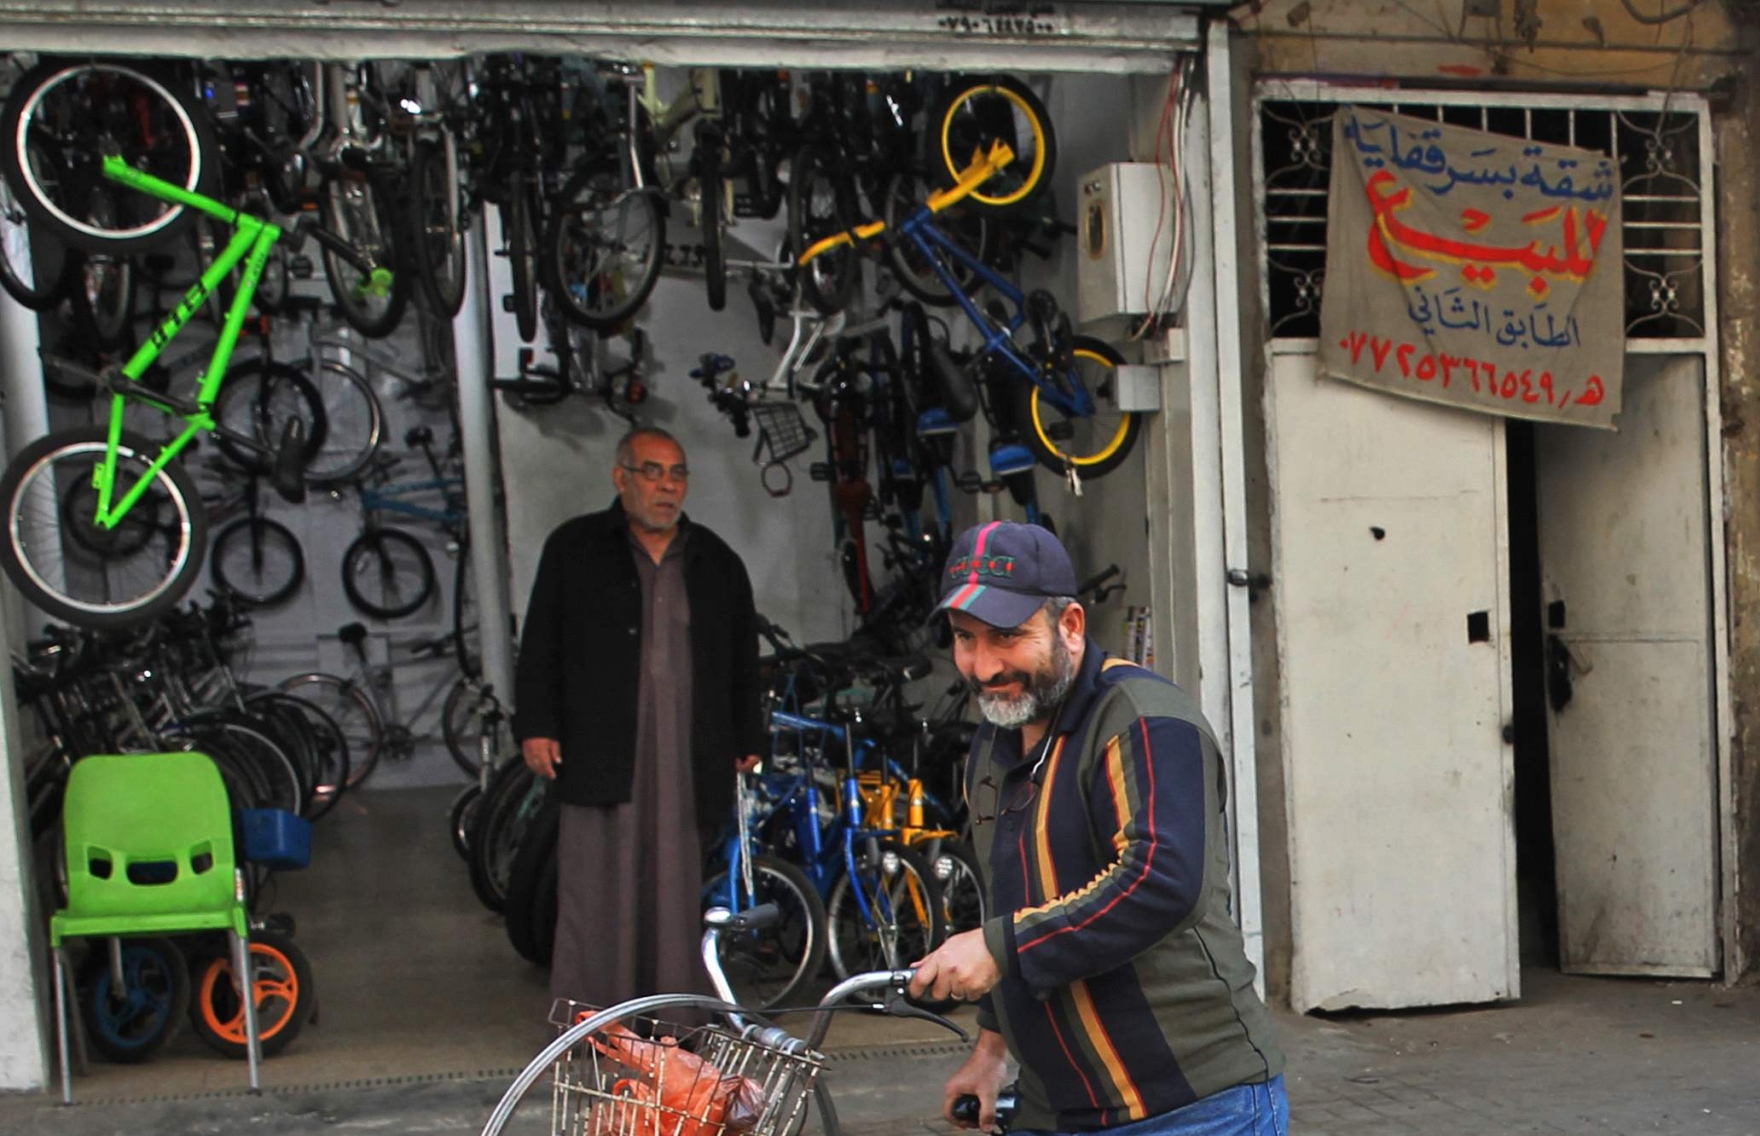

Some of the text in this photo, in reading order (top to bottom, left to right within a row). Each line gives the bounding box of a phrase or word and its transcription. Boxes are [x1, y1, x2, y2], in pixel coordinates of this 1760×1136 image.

[1520, 145, 1614, 200] شقة
[1366, 170, 1608, 299] للبيع
[1408, 285, 1581, 350] الطابق الثاني
